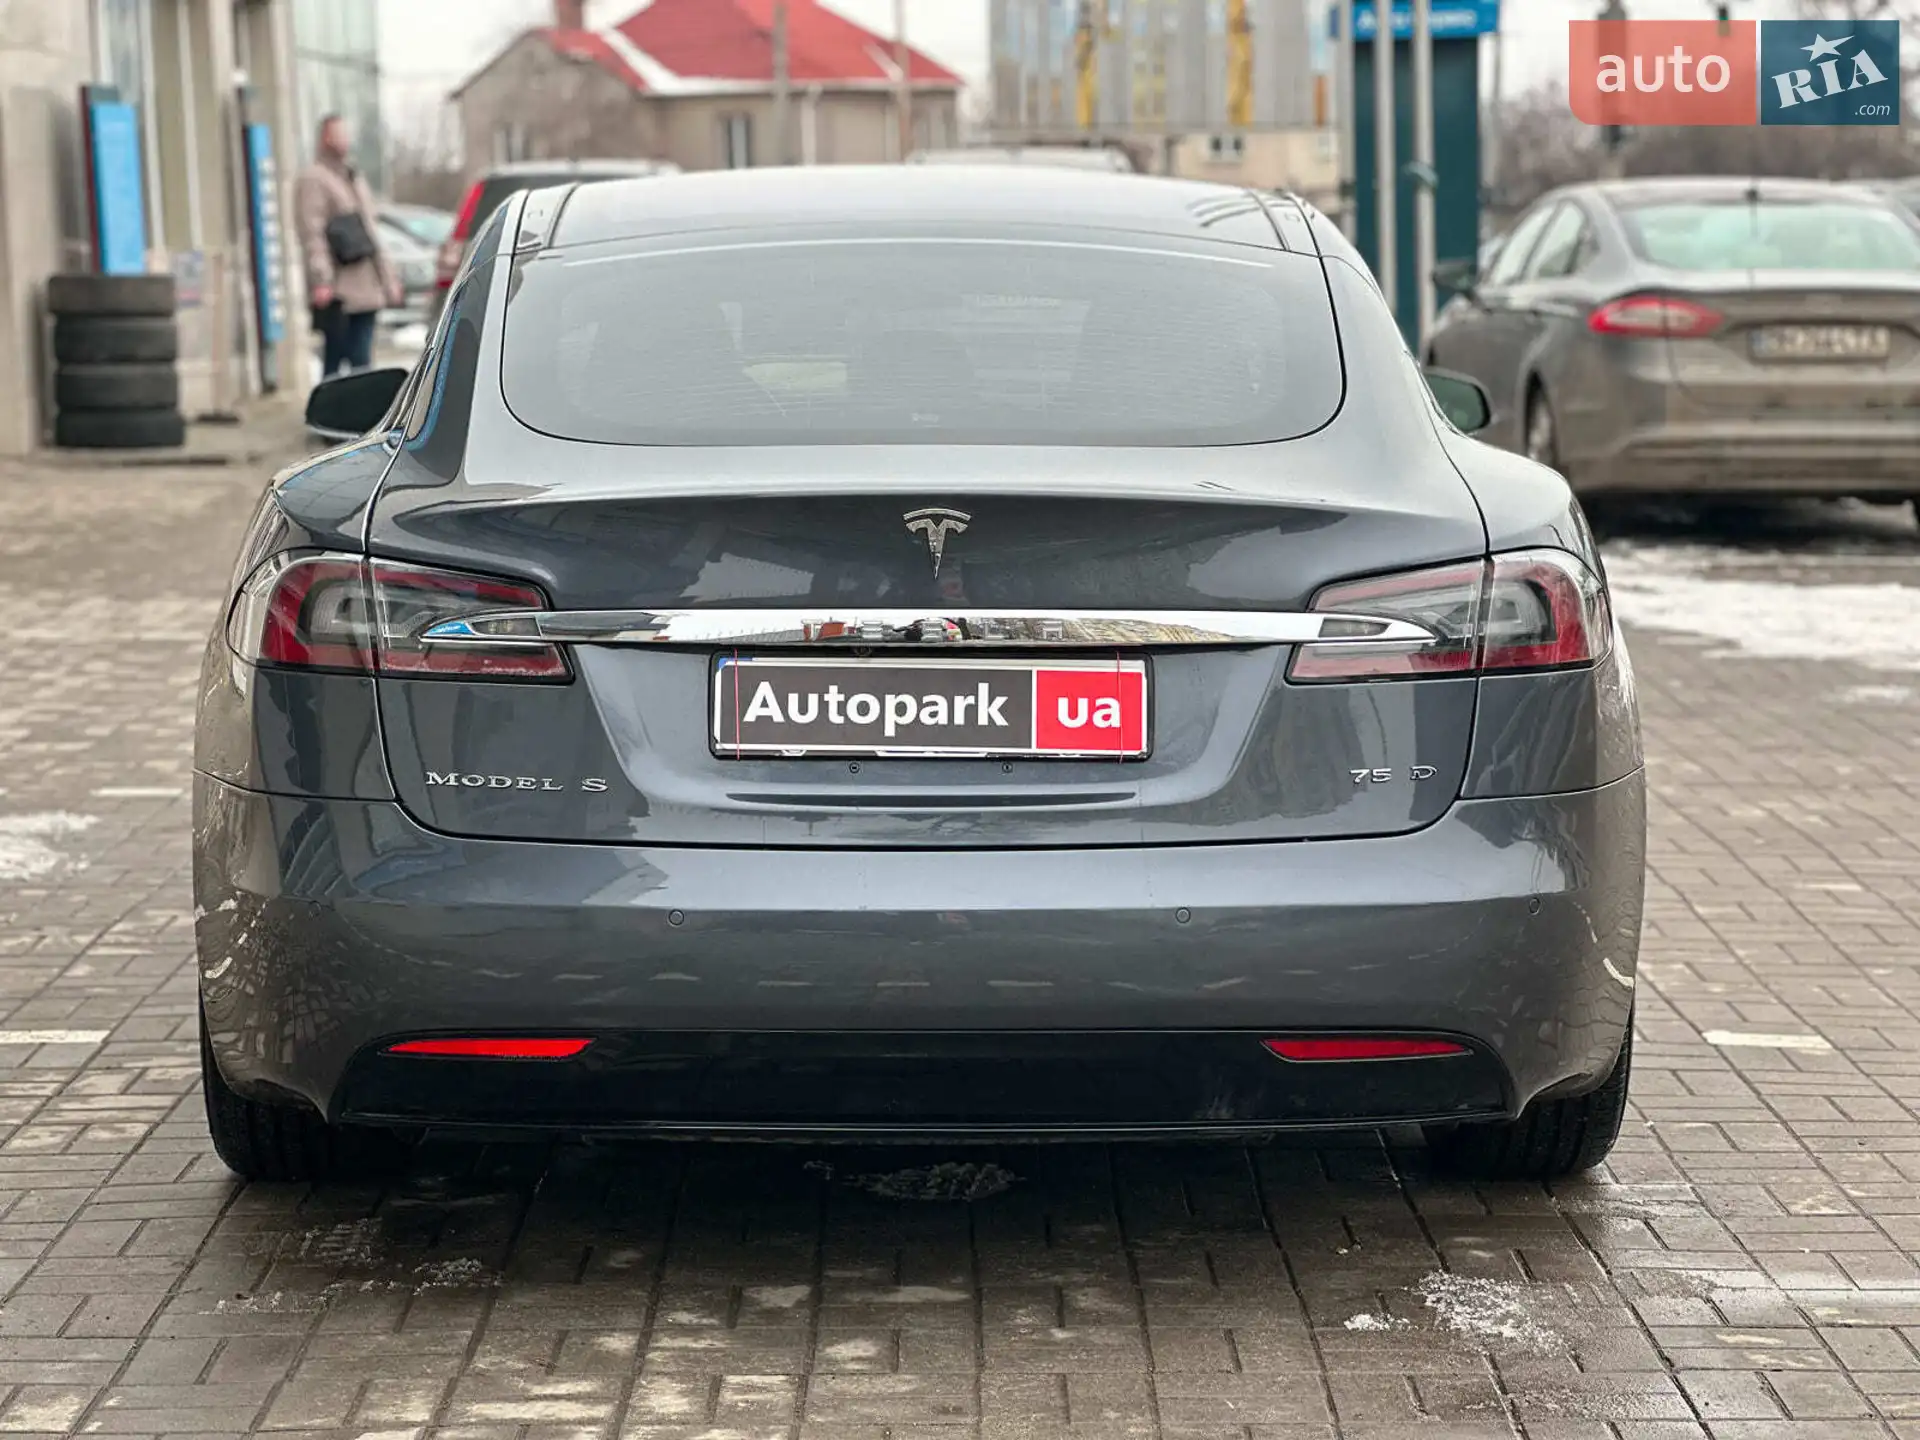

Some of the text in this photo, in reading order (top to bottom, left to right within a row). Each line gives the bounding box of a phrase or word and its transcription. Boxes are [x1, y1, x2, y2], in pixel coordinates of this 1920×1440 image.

[743, 681, 1121, 737] Autopark ua
[425, 771, 609, 792] MODEL S
[1350, 765, 1437, 783] 75 D
